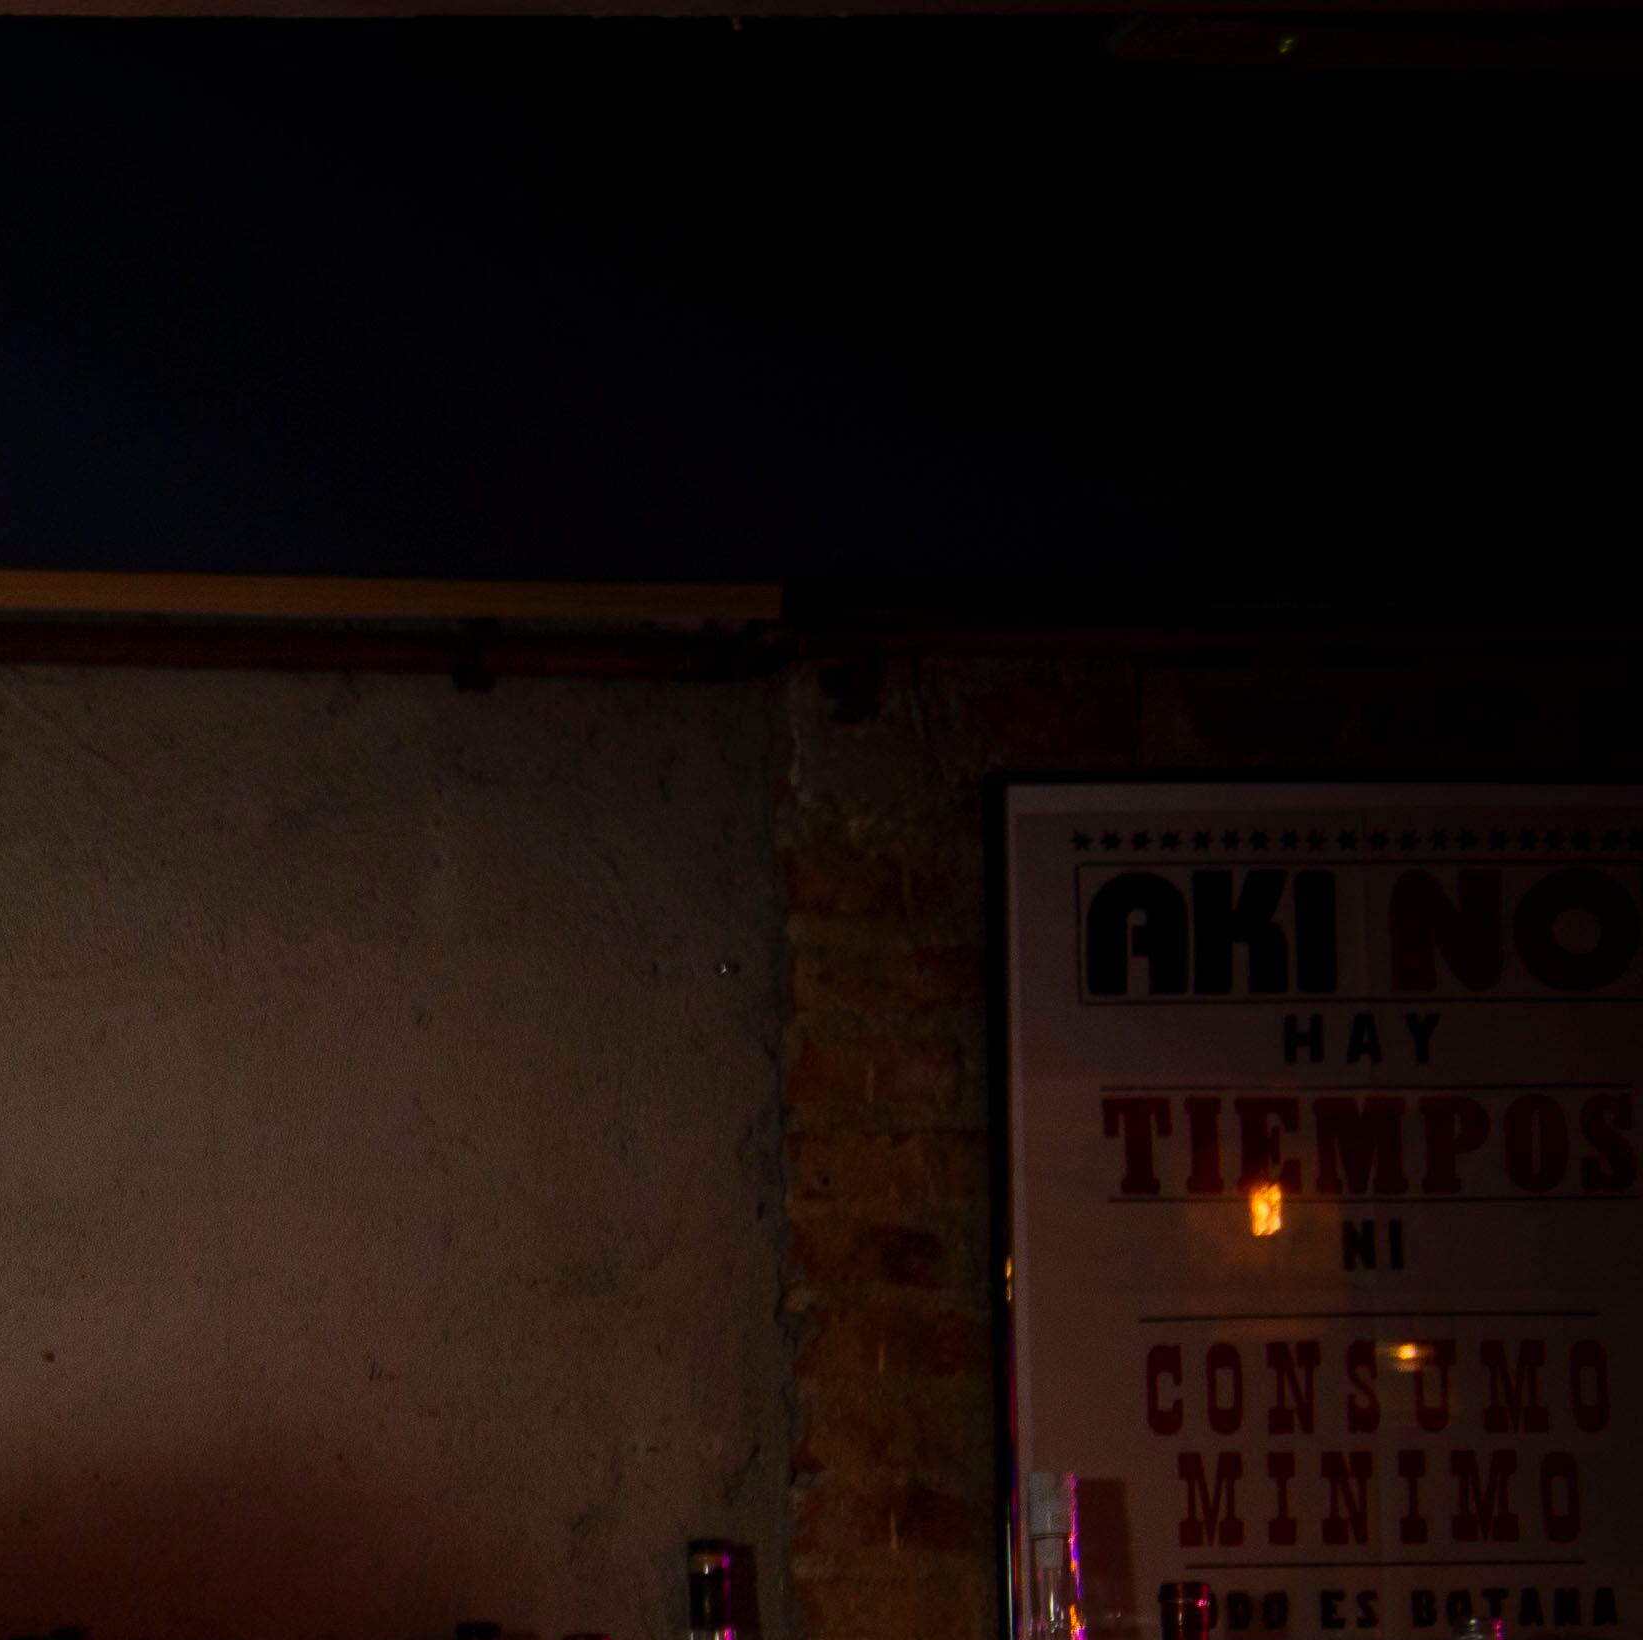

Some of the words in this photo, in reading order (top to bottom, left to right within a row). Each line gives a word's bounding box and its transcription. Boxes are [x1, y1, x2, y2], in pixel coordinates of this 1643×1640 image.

[1088, 869, 1337, 994] AKI
[1390, 866, 1641, 992] NO
[1285, 1013, 1440, 1063] HAY
[1103, 1094, 1639, 1197] TIEMPOS
[1343, 1220, 1403, 1270] NI
[1147, 1339, 1611, 1435] CONSUMO
[1178, 1450, 1582, 1546] MINIMO
[1321, 1589, 1379, 1628] ES
[1413, 1587, 1618, 1629] BOTANA
